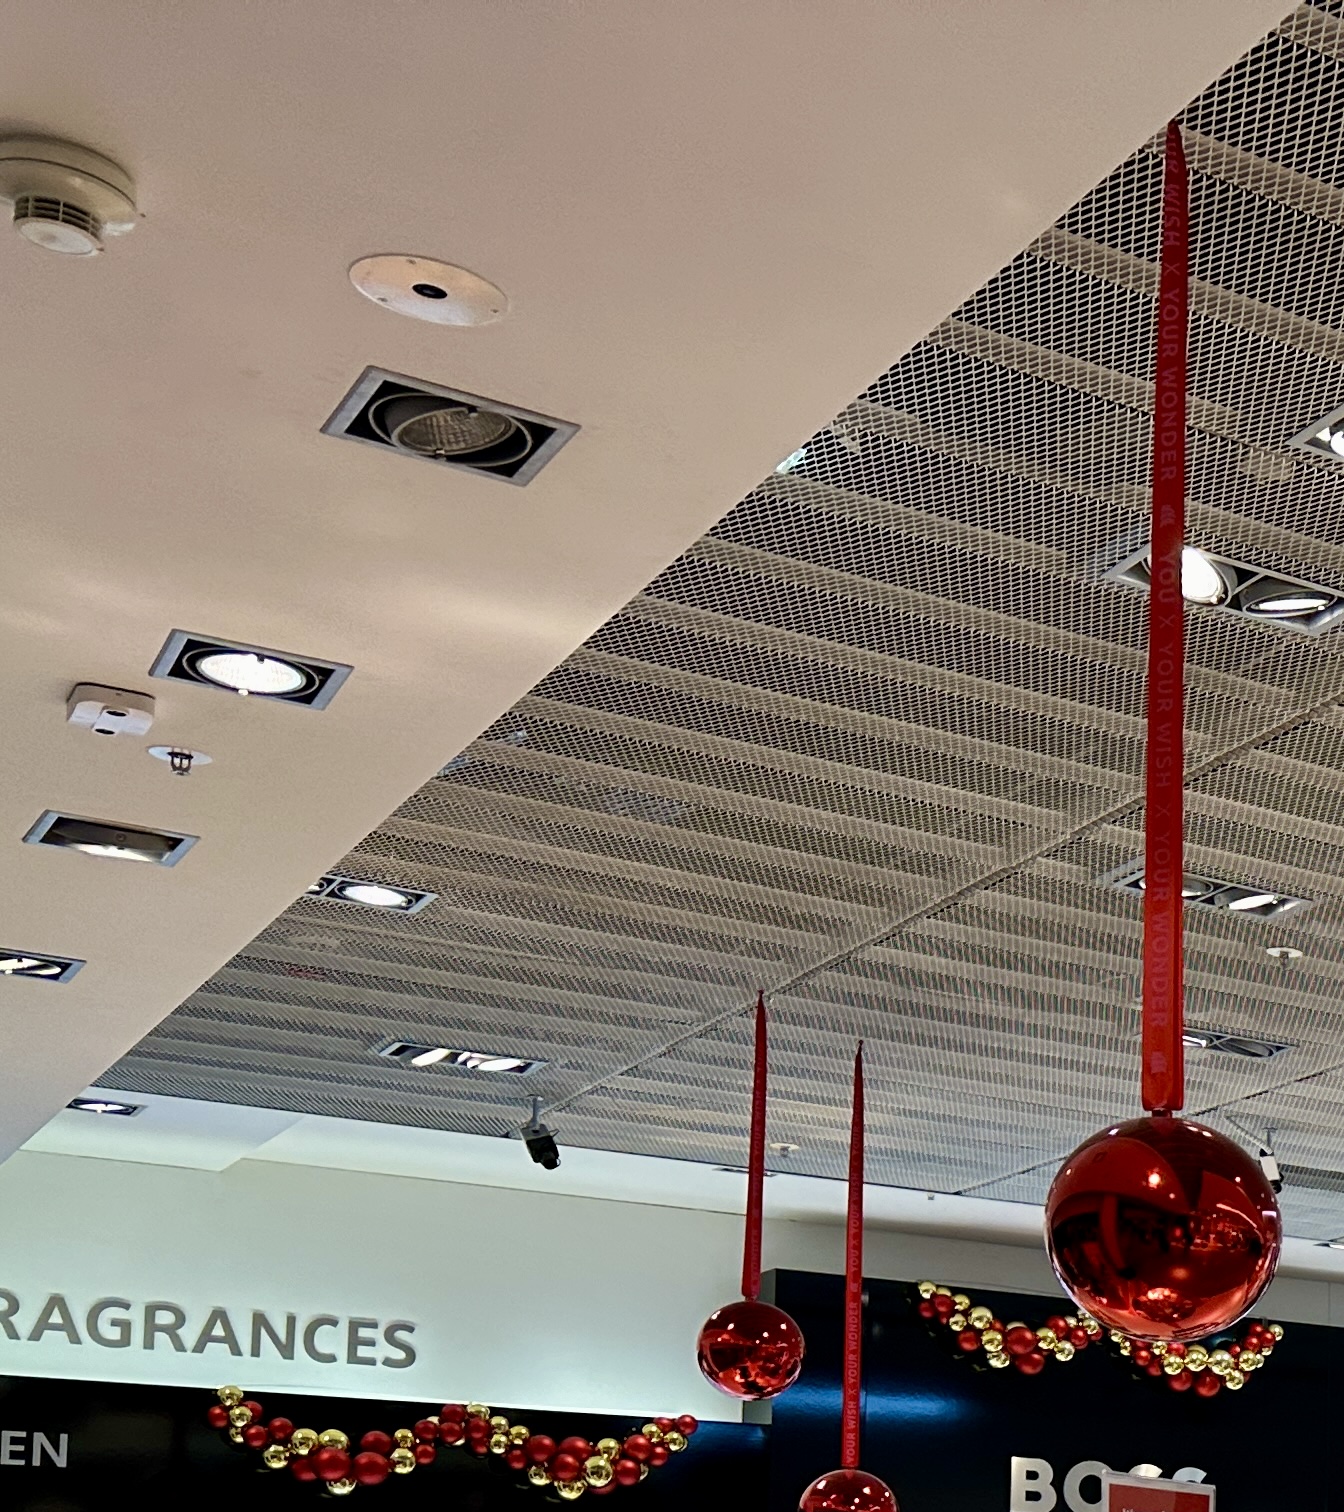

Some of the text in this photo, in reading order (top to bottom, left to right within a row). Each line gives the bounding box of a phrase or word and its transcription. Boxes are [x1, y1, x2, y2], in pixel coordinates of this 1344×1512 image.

[848, 1302, 859, 1348] WONDER
[848, 1353, 859, 1388] YOUR
[847, 1401, 858, 1428] WISH
[846, 1428, 858, 1464] YOUR
